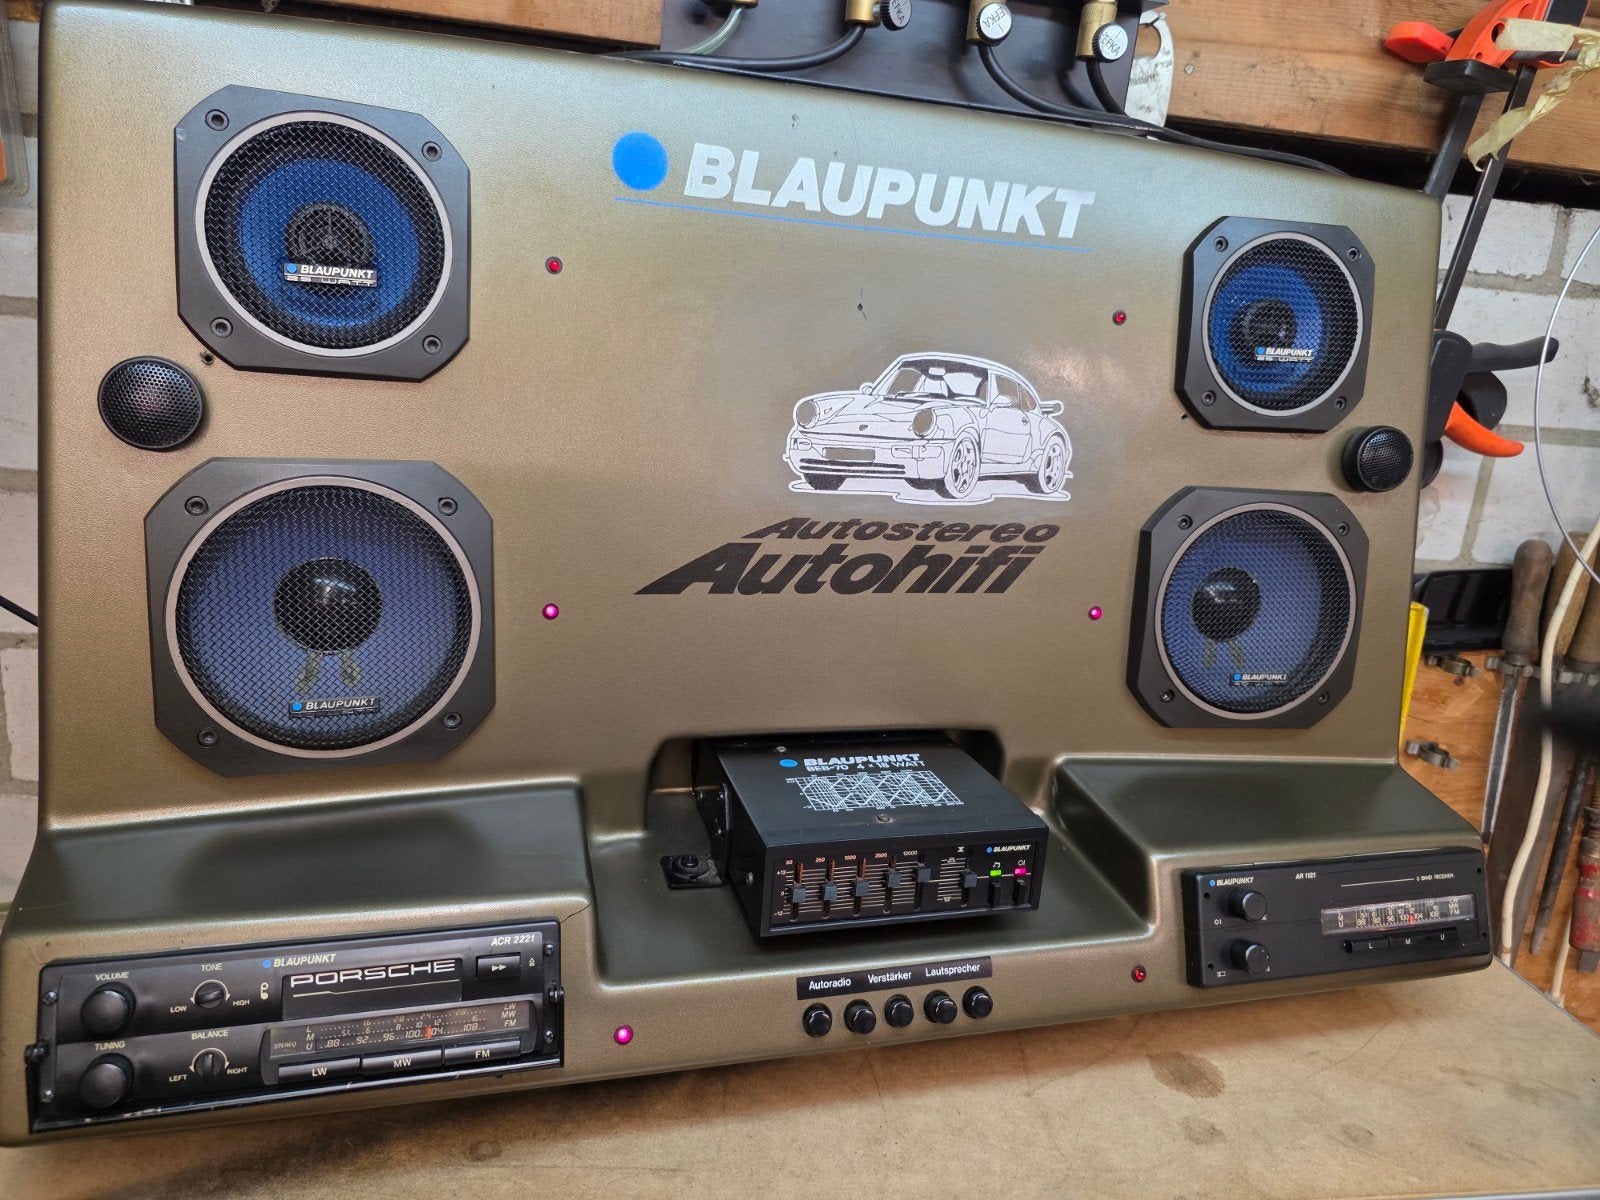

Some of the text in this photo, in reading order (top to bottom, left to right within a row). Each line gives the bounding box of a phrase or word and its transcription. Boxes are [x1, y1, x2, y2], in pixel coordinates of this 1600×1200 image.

[684, 142, 1096, 239] BLAUPUNKT
[300, 264, 374, 279] BLAUPUNKT
[1266, 347, 1313, 356] BLAUPUNKT
[740, 517, 1060, 543] Autostereo
[632, 542, 1047, 596] Autohifi
[306, 698, 376, 710] BLAUPUNKT
[804, 754, 920, 766] BLAUPUNKT
[993, 844, 1031, 852] BLAUPUNKT
[1216, 877, 1254, 886] BLAUPUNKT
[491, 934, 535, 947] ACR 2221
[274, 953, 336, 968] BLAUPUNKT
[201, 963, 223, 972] TONE
[290, 959, 456, 987] PORSCHE
[95, 972, 130, 981] VOLUME
[809, 963, 981, 990] Autoradio Verstärker Lautsprecher
[170, 1005, 187, 1013] LOW
[501, 1010, 516, 1018] MW
[191, 1030, 229, 1040] BALANCE
[327, 1039, 340, 1047] 88
[383, 1033, 395, 1041] 96
[405, 1030, 420, 1038] 100
[463, 1023, 478, 1031] 108
[94, 1040, 126, 1050] TUNING
[312, 1049, 490, 1077] LW MW FM
[226, 1067, 248, 1075] RIGHT
[169, 1074, 187, 1082] LEFT
